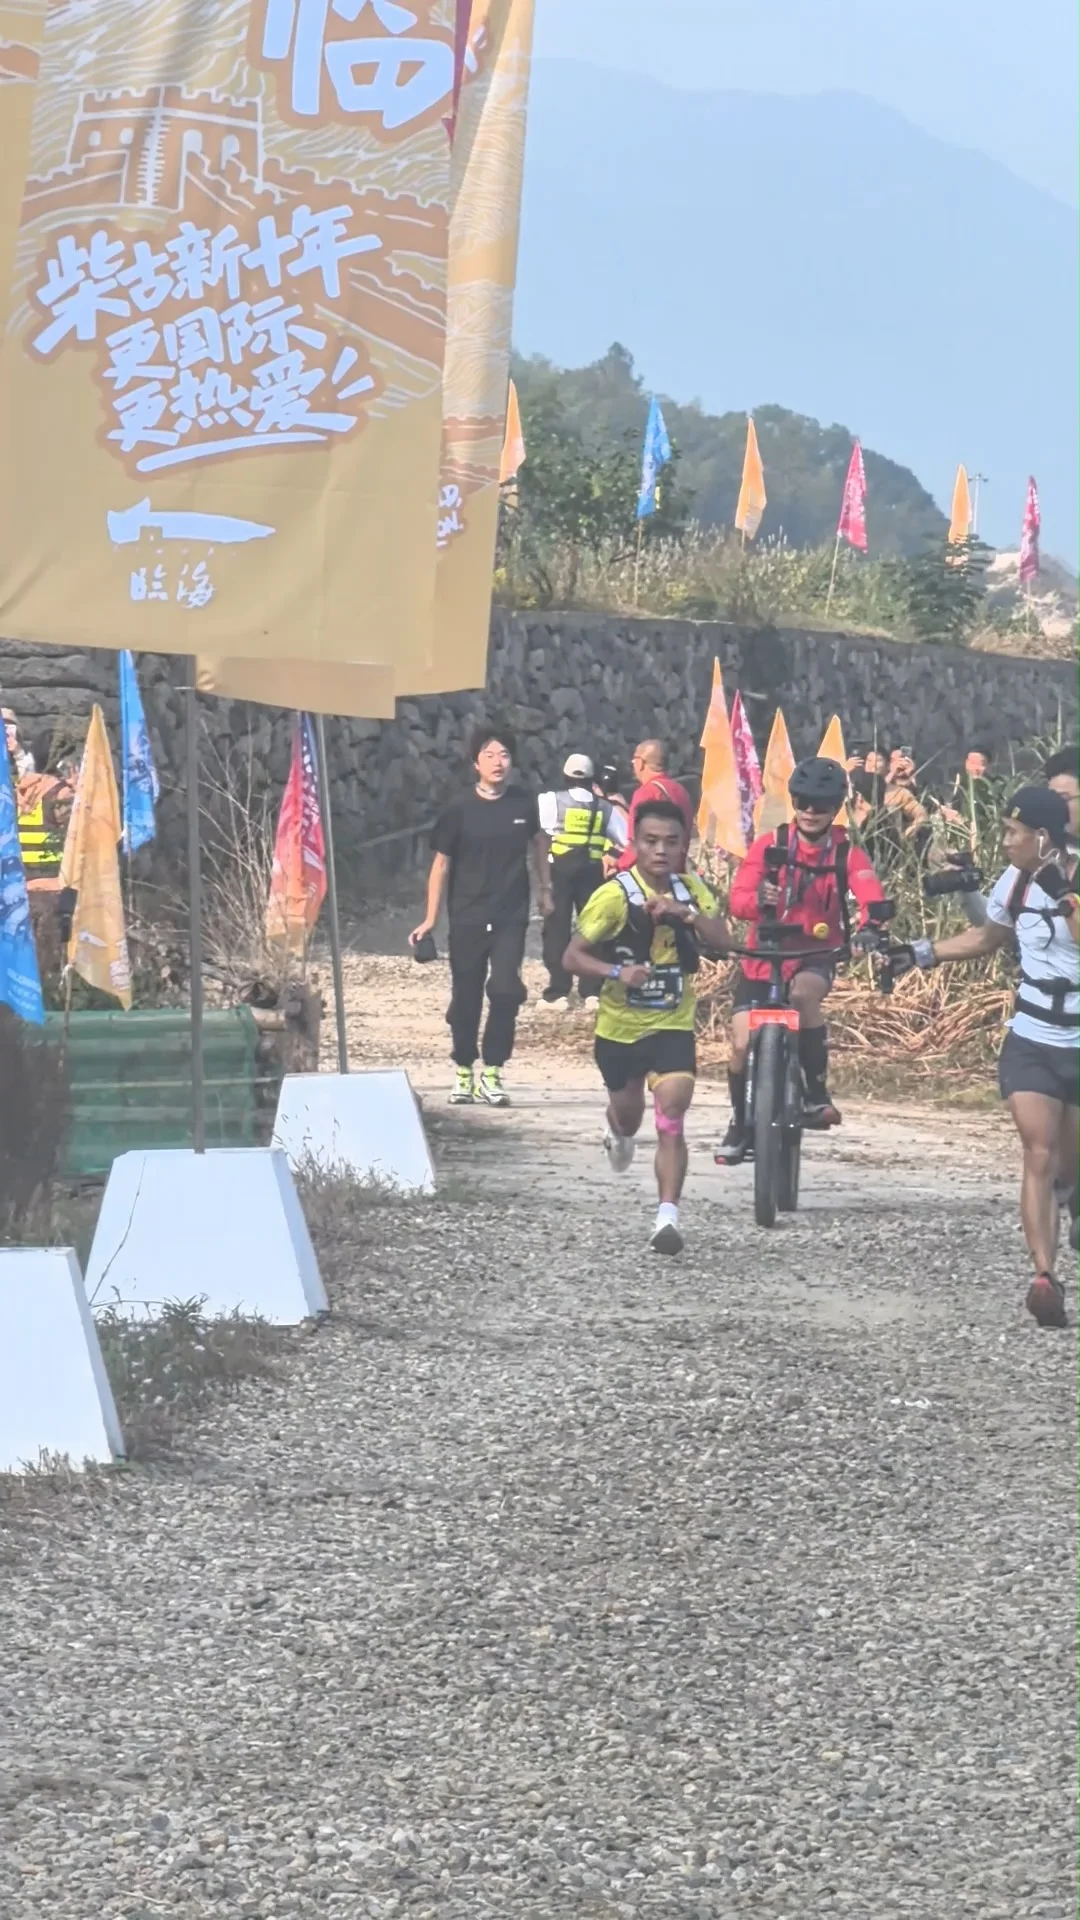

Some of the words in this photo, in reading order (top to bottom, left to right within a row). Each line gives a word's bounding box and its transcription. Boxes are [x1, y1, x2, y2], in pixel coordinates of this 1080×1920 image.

[32, 205, 383, 354] 柴古新十年
[102, 296, 327, 389] 更国际
